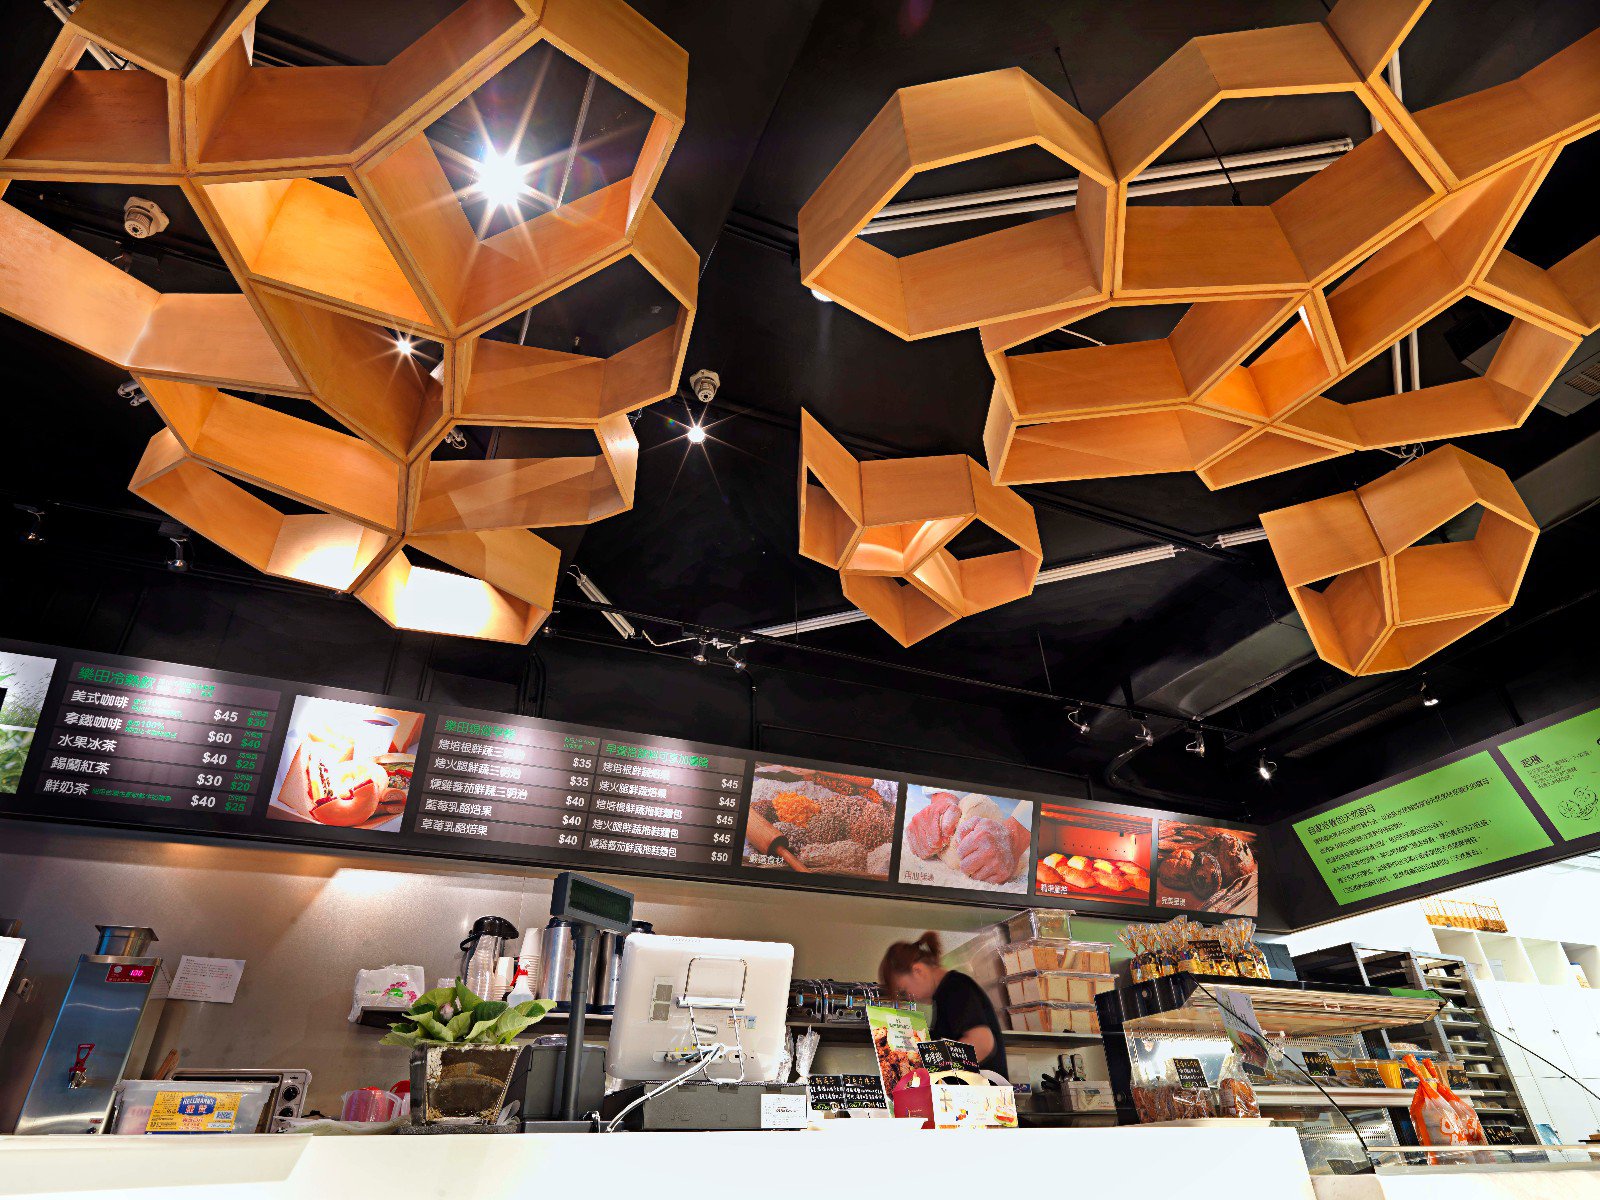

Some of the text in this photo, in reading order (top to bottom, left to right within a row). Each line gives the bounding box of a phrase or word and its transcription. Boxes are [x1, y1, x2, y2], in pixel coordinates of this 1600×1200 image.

[71, 690, 129, 708] 美式咖啡
[213, 709, 238, 722] $45
[246, 717, 267, 727] $30
[64, 712, 122, 730] 拿鐵咖啡
[207, 731, 232, 743] $60
[240, 739, 261, 749] $40
[57, 734, 118, 752] 水果冰茶
[202, 752, 227, 764] $40
[235, 760, 256, 770] $25
[438, 738, 592, 769] 烤培根鮮蔬三 $35
[50, 756, 110, 774] 錫蘭紅茶
[196, 774, 222, 786] $30
[230, 781, 251, 791] $20
[569, 775, 589, 787] $35
[721, 778, 739, 789] $45
[43, 779, 90, 795] 鮮奶茶
[190, 795, 216, 807] $40
[224, 802, 246, 812] $25
[565, 795, 585, 807] $40
[718, 797, 736, 808] $45
[425, 799, 581, 826] 藍莓乳酪焙果 $40
[716, 814, 734, 825] $45
[421, 818, 578, 845] 草莓乳酪焙果 $40
[713, 832, 731, 844] $45
[710, 851, 729, 862] $50
